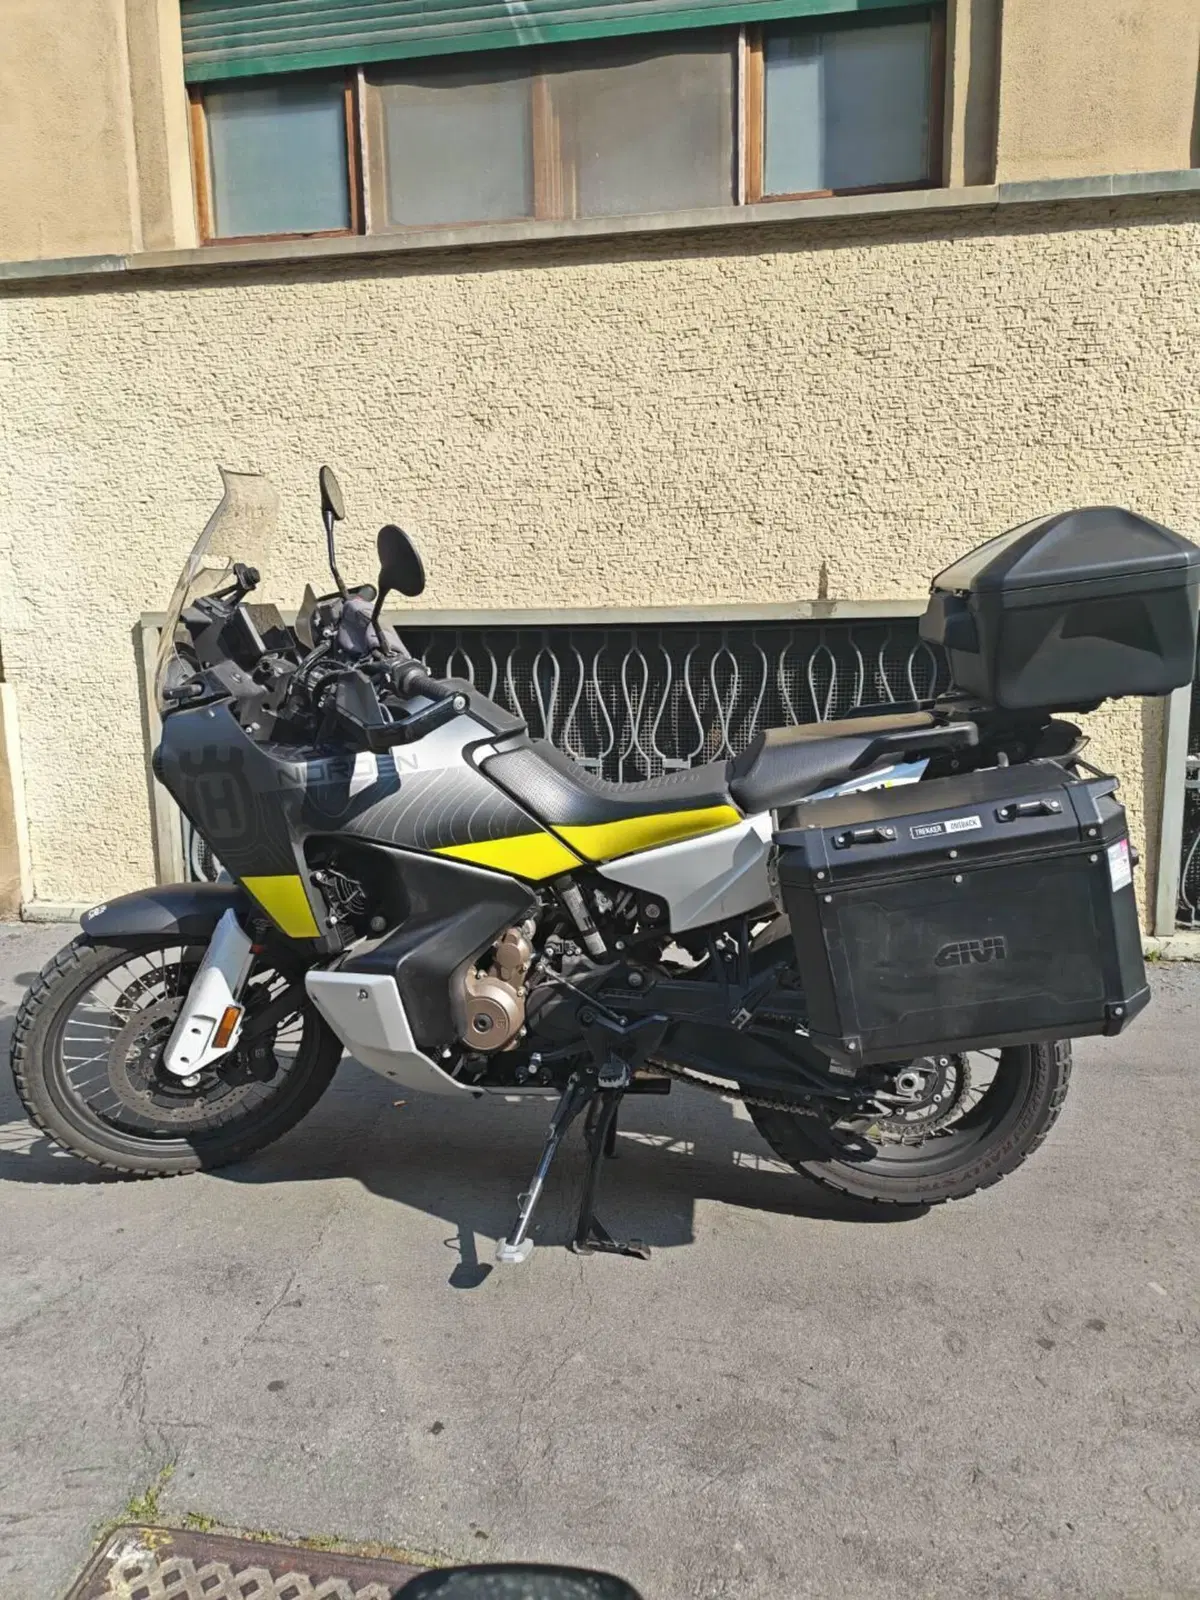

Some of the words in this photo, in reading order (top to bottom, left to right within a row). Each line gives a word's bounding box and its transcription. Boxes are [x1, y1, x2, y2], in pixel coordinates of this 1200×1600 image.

[277, 752, 419, 786] NORDEN
[915, 824, 942, 836] TREKKER
[934, 936, 1006, 967] GIVI
